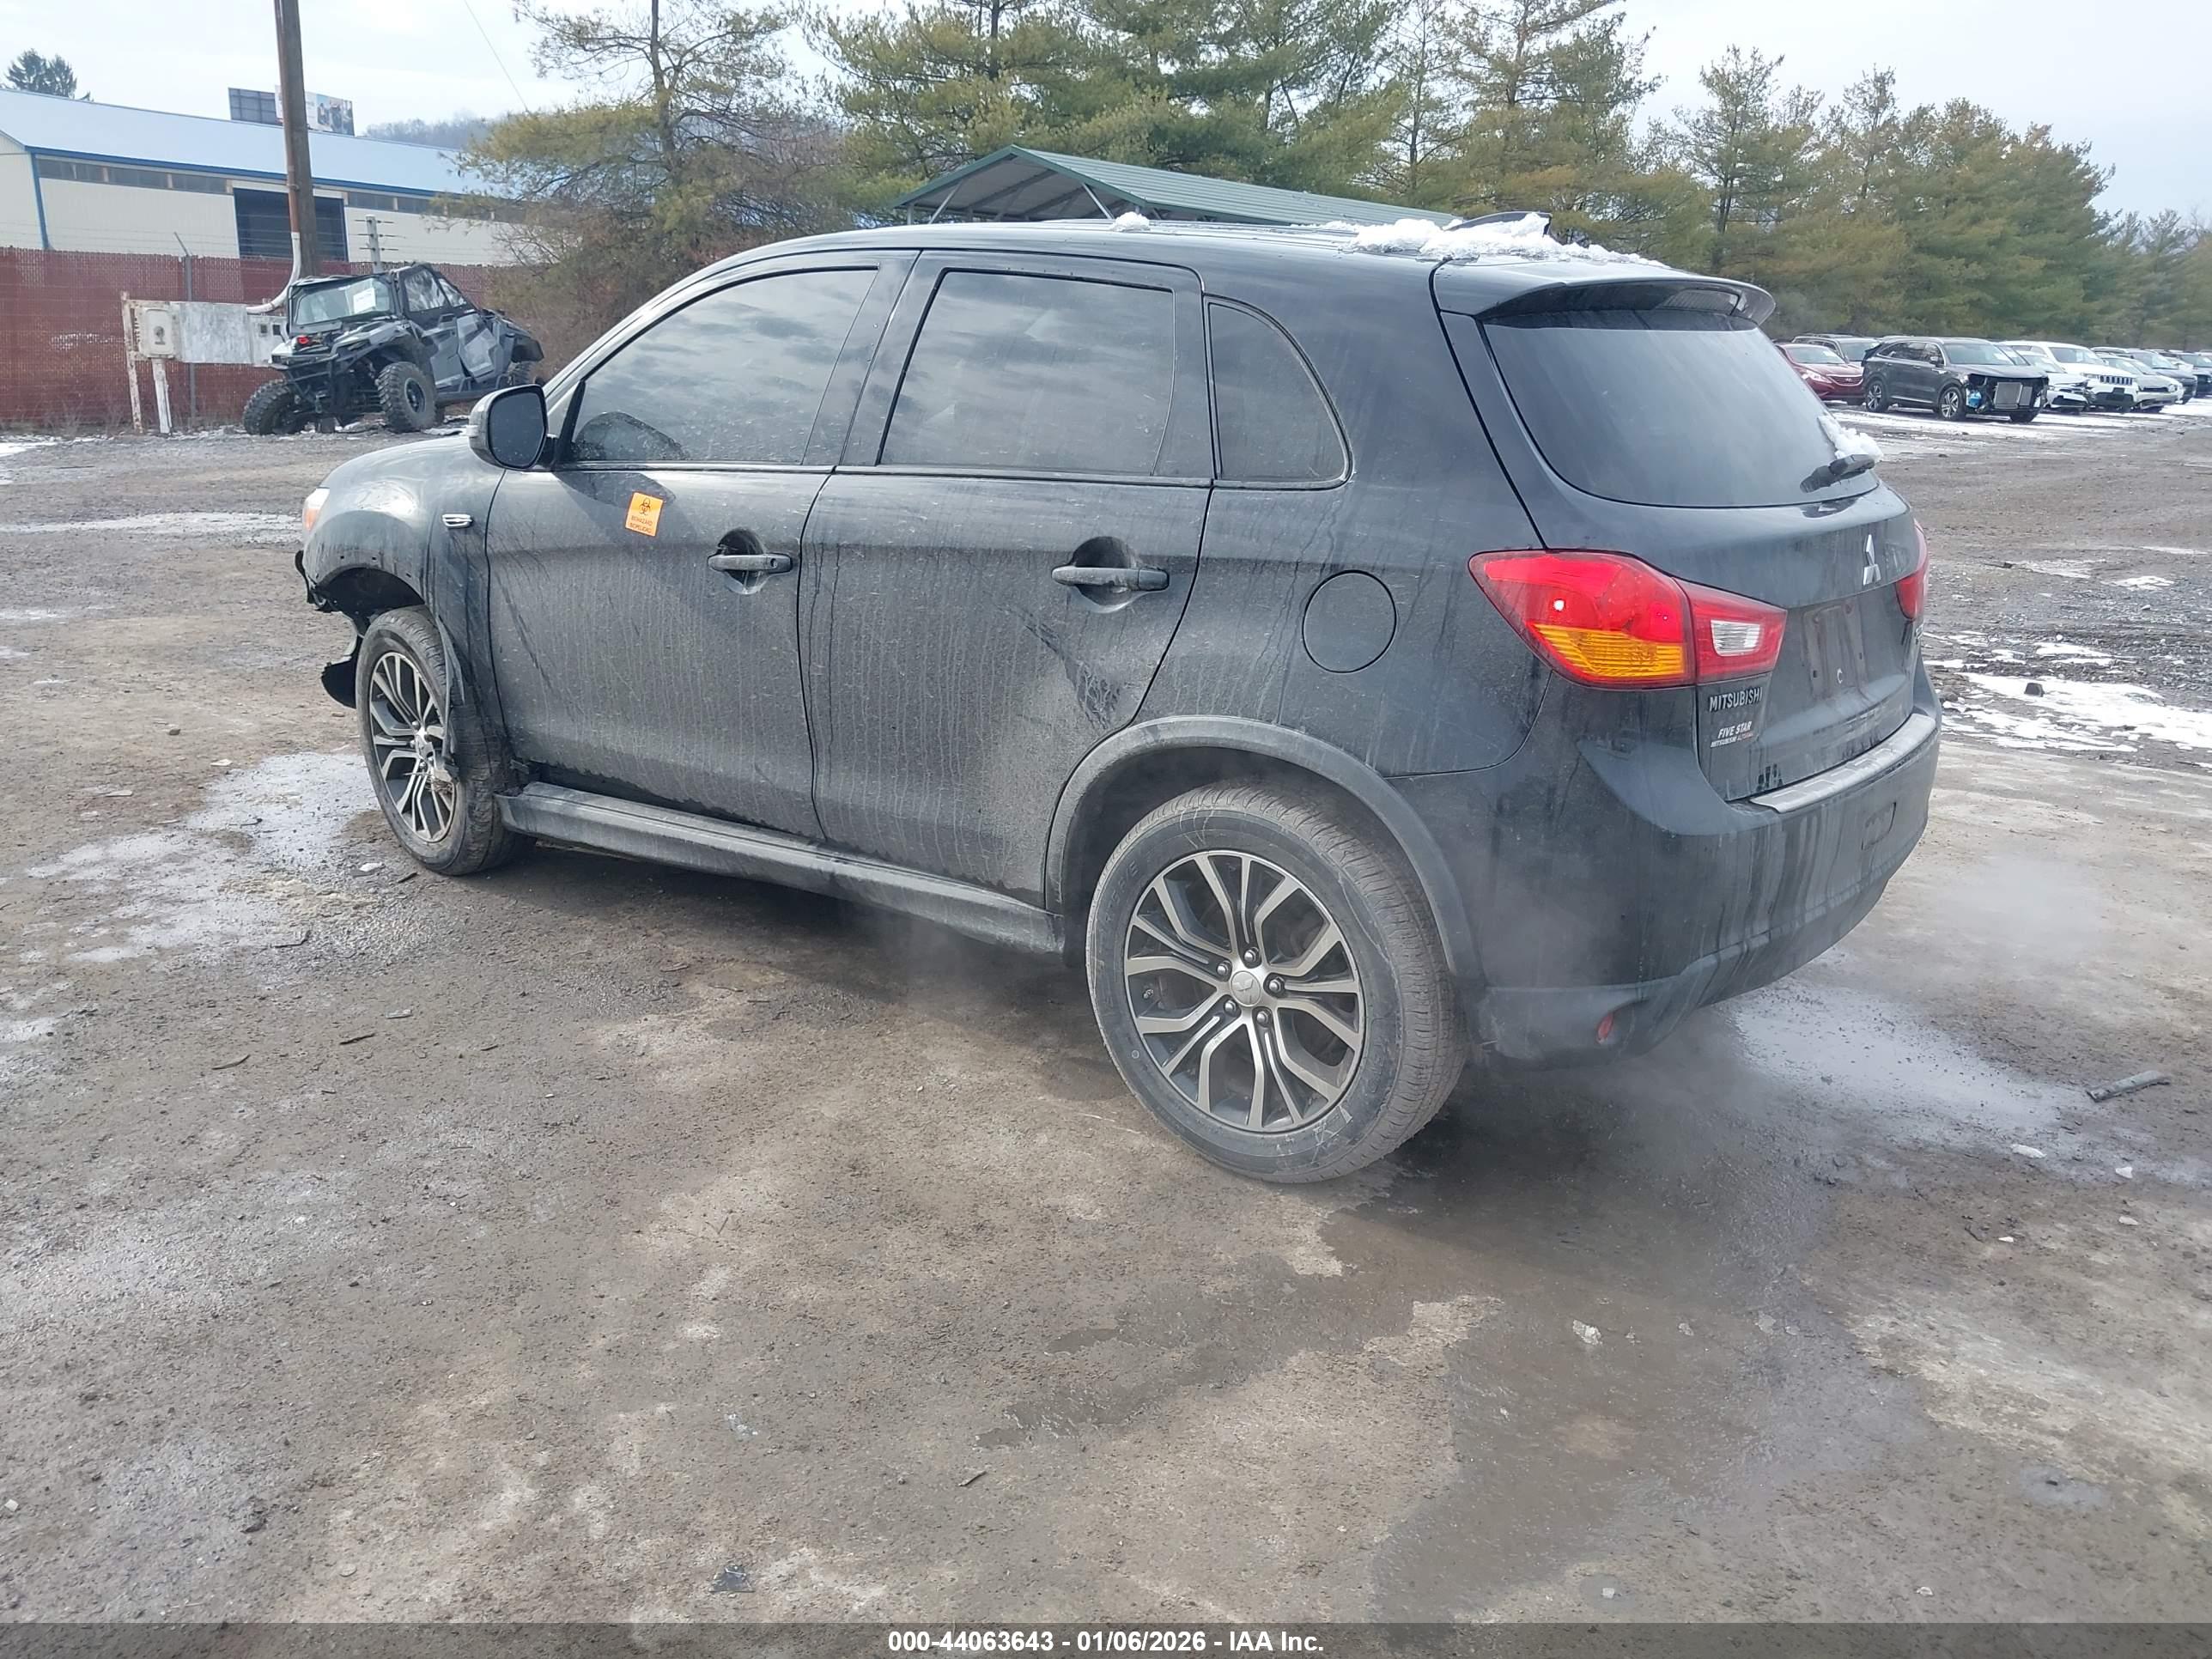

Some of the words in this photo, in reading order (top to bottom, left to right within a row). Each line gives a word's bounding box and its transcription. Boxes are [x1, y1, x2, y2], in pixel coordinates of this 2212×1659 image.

[1709, 687, 1763, 713] MITSUBISHI
[1717, 726, 1735, 739] FIVE
[1736, 721, 1752, 735] STAR
